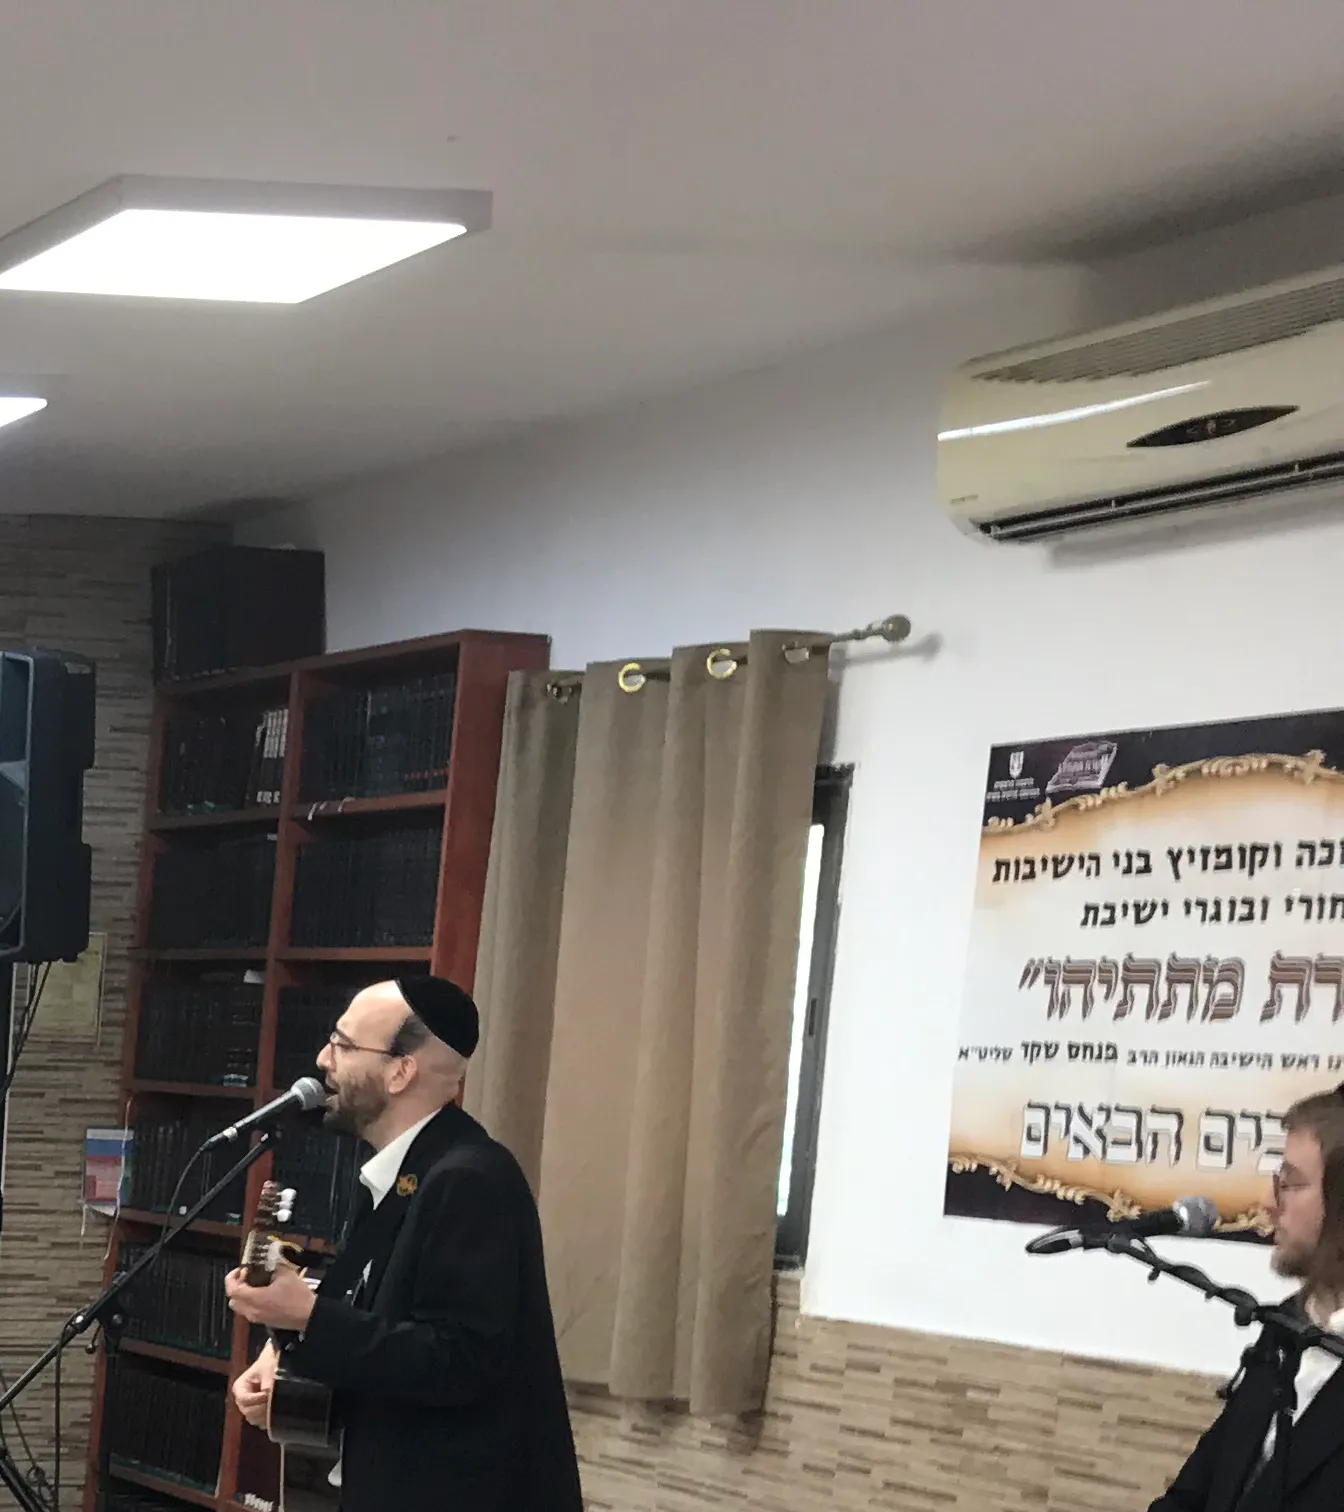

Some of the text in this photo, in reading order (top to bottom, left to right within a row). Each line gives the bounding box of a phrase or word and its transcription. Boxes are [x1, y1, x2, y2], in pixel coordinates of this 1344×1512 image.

[992, 852, 1101, 884] הישיבות
[1112, 848, 1154, 877] בני
[1167, 840, 1282, 882] וקומזיץ
[1079, 897, 1169, 928] ישיבת
[1183, 895, 1270, 926] ובוגרי
[1021, 1039, 1060, 1066] שקד
[1067, 1040, 1118, 1064] פנחס
[1127, 1048, 1159, 1067] הרב
[1164, 1048, 1205, 1069] הגאון
[1210, 1051, 1273, 1071] הישיבה
[1280, 1053, 1319, 1073] ראש
[1020, 1099, 1185, 1168] הבאים
